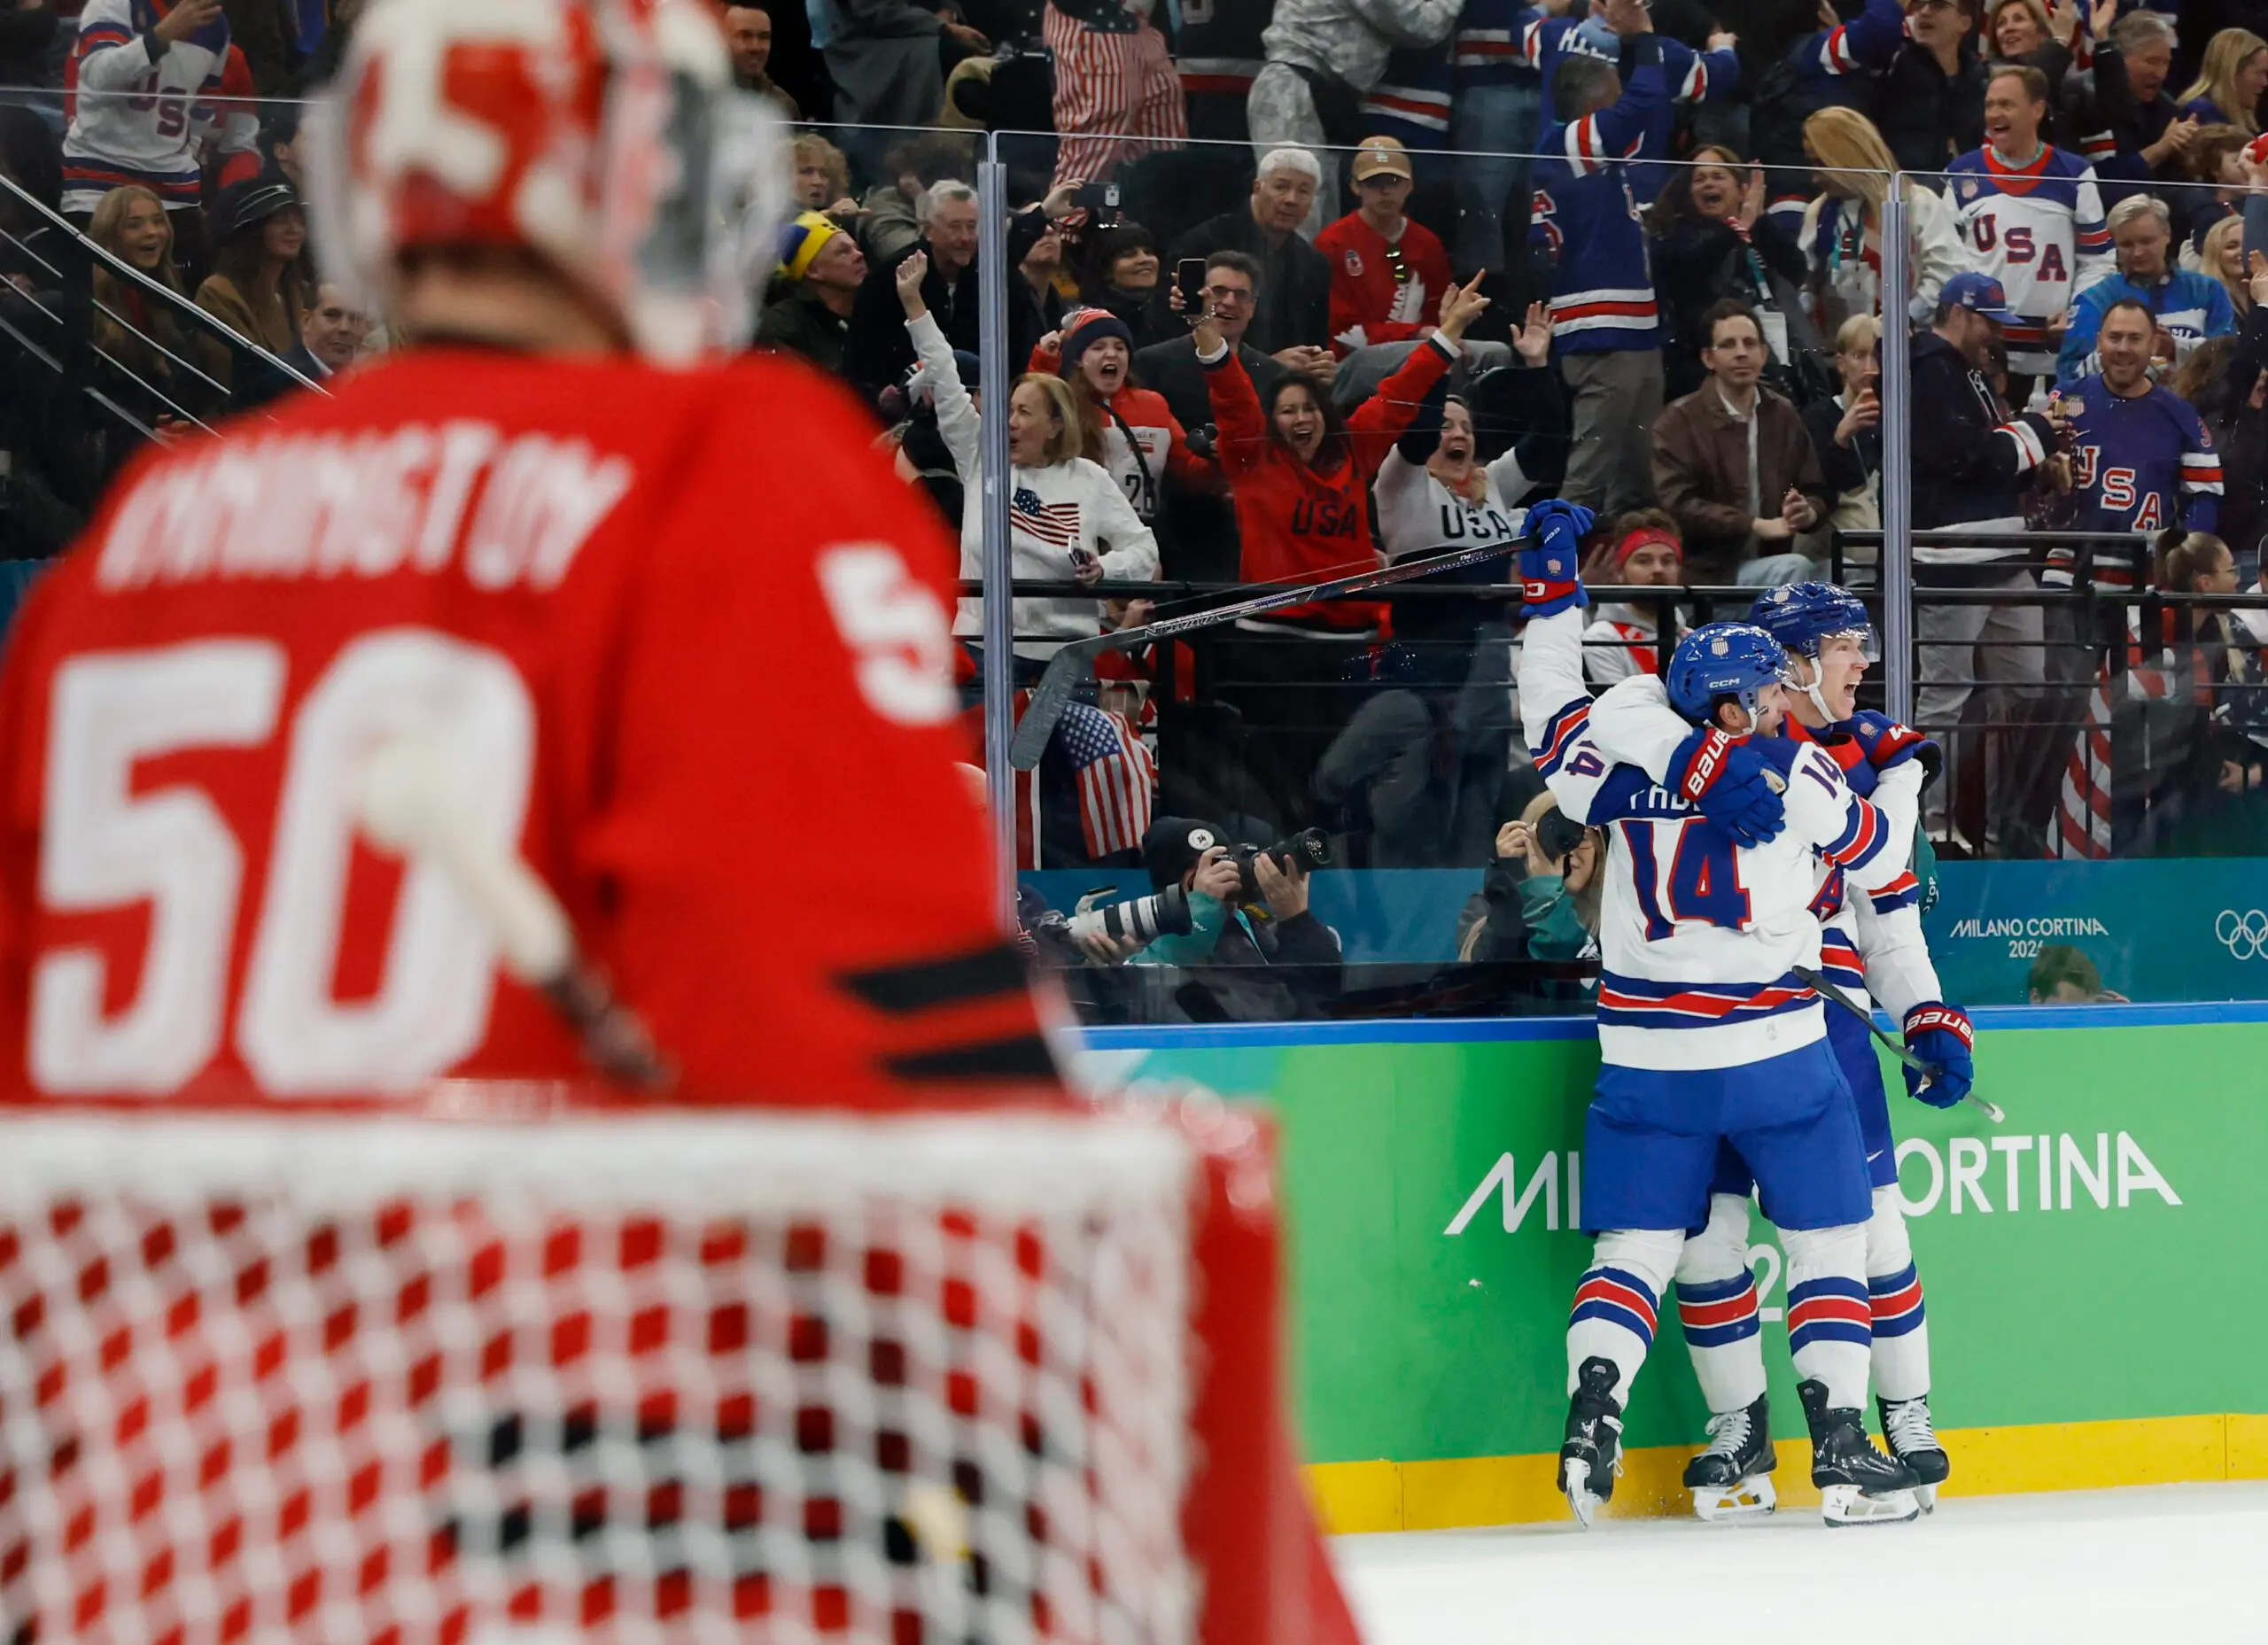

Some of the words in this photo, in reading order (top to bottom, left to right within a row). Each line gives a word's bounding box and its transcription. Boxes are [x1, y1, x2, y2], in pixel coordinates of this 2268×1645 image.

[1973, 213, 2067, 282] USA
[1293, 498, 1357, 539] USA
[1441, 504, 1513, 539] USA
[2073, 445, 2162, 532] USA
[1709, 678, 1740, 689] CCM
[1687, 729, 1730, 796] BAUE
[27, 625, 536, 1098] 50
[1619, 817, 1752, 943] 14
[1949, 919, 2023, 937] MILANO
[2026, 917, 2109, 936] CORTINA
[1894, 1130, 2184, 1217] ORTINA
